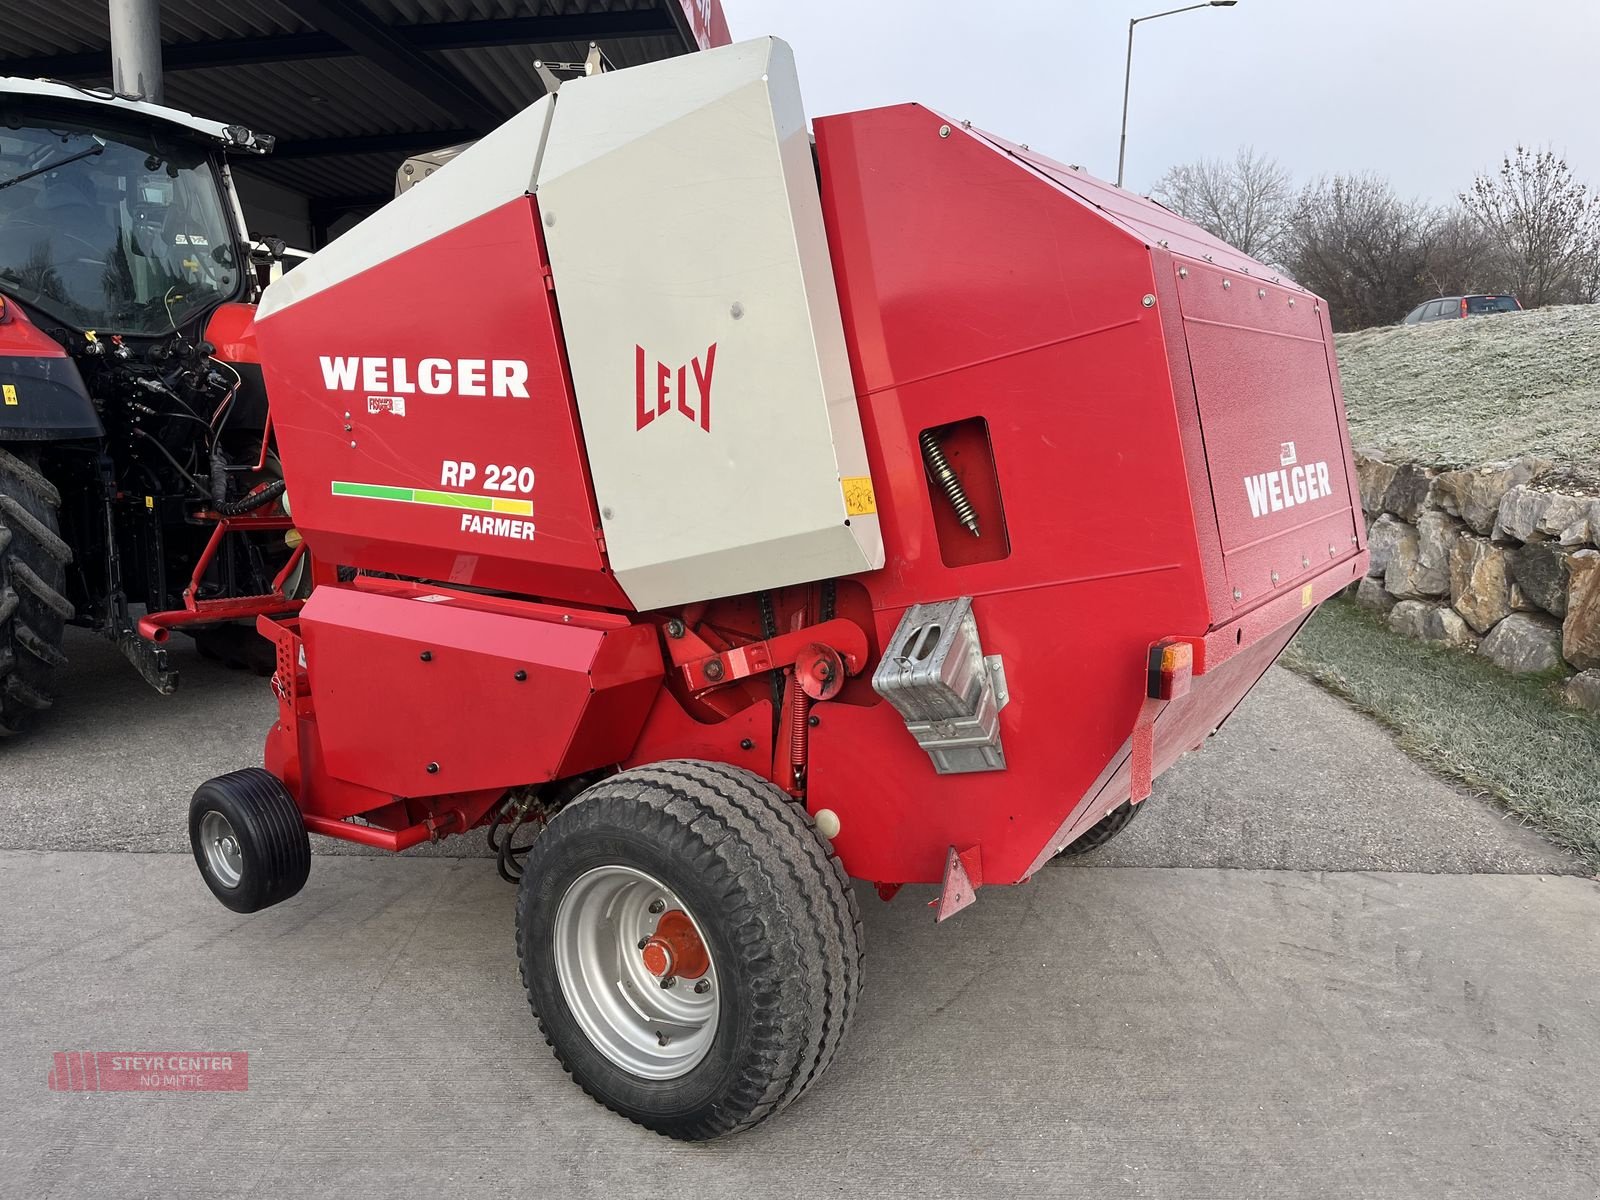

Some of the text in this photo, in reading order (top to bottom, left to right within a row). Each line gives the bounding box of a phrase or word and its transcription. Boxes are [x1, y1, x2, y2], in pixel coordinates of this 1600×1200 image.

[319, 356, 530, 398] WELGER
[636, 342, 717, 433] LELY
[440, 460, 535, 493] RP 220
[1244, 461, 1332, 518] WELGER
[461, 513, 535, 541] FARMER
